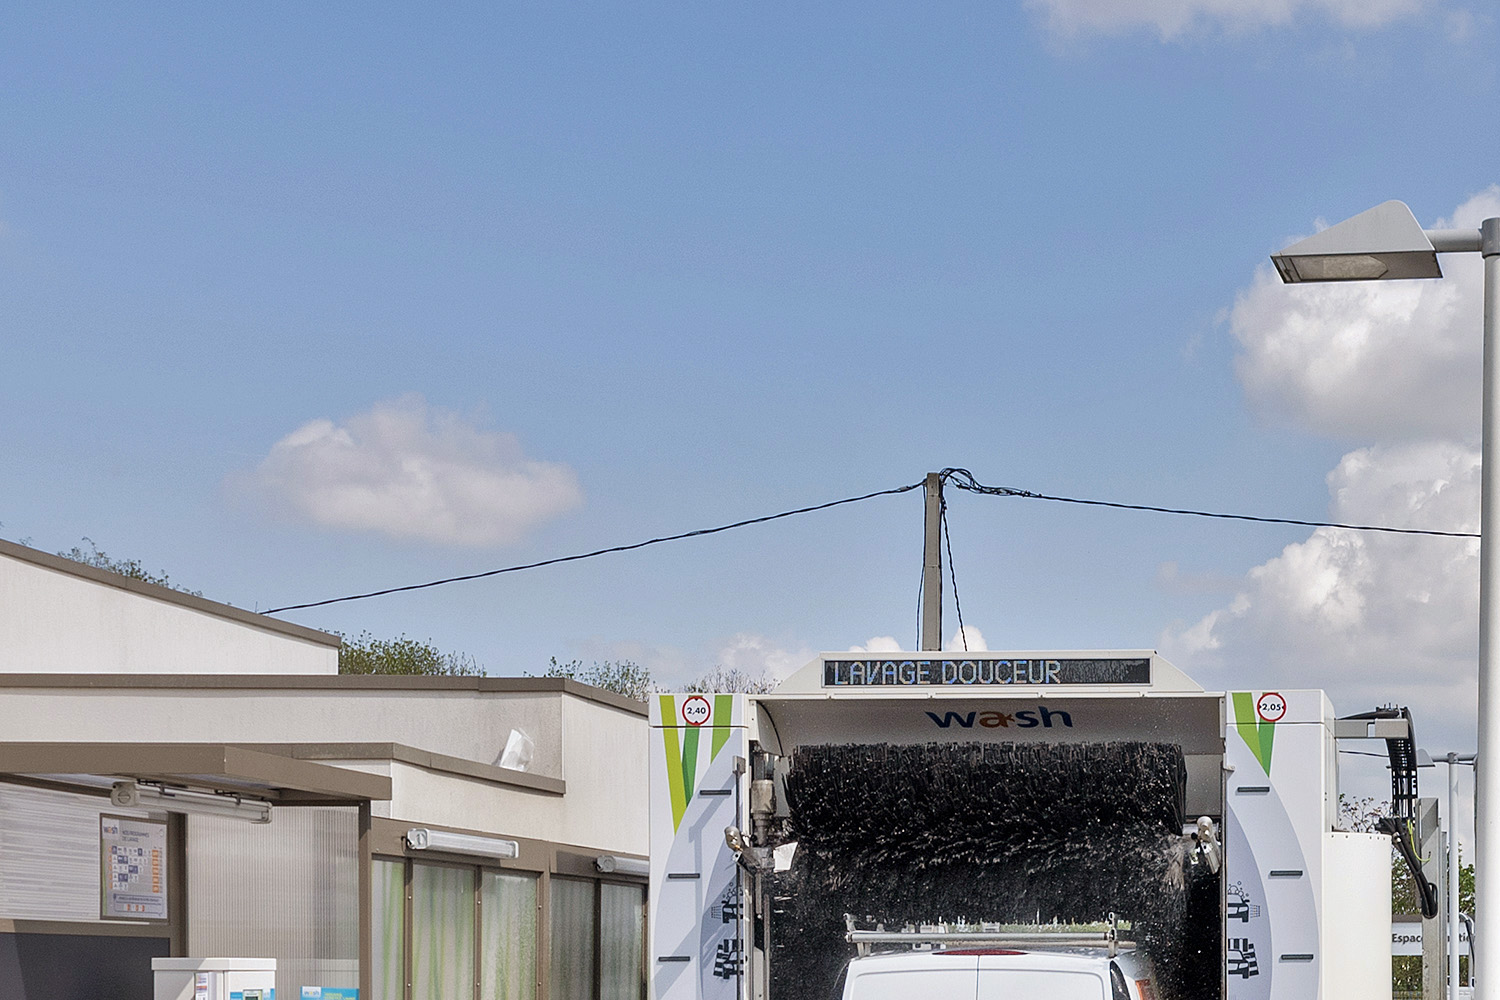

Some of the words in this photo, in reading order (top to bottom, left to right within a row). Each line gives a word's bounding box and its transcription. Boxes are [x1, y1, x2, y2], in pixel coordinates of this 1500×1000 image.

[834, 660, 931, 686] LAVAGE
[942, 660, 1062, 685] DOUCEUR
[687, 707, 706, 715] 2,40
[1262, 703, 1281, 711] 2,05
[924, 706, 1074, 729] wash
[1391, 933, 1423, 945] Espac
